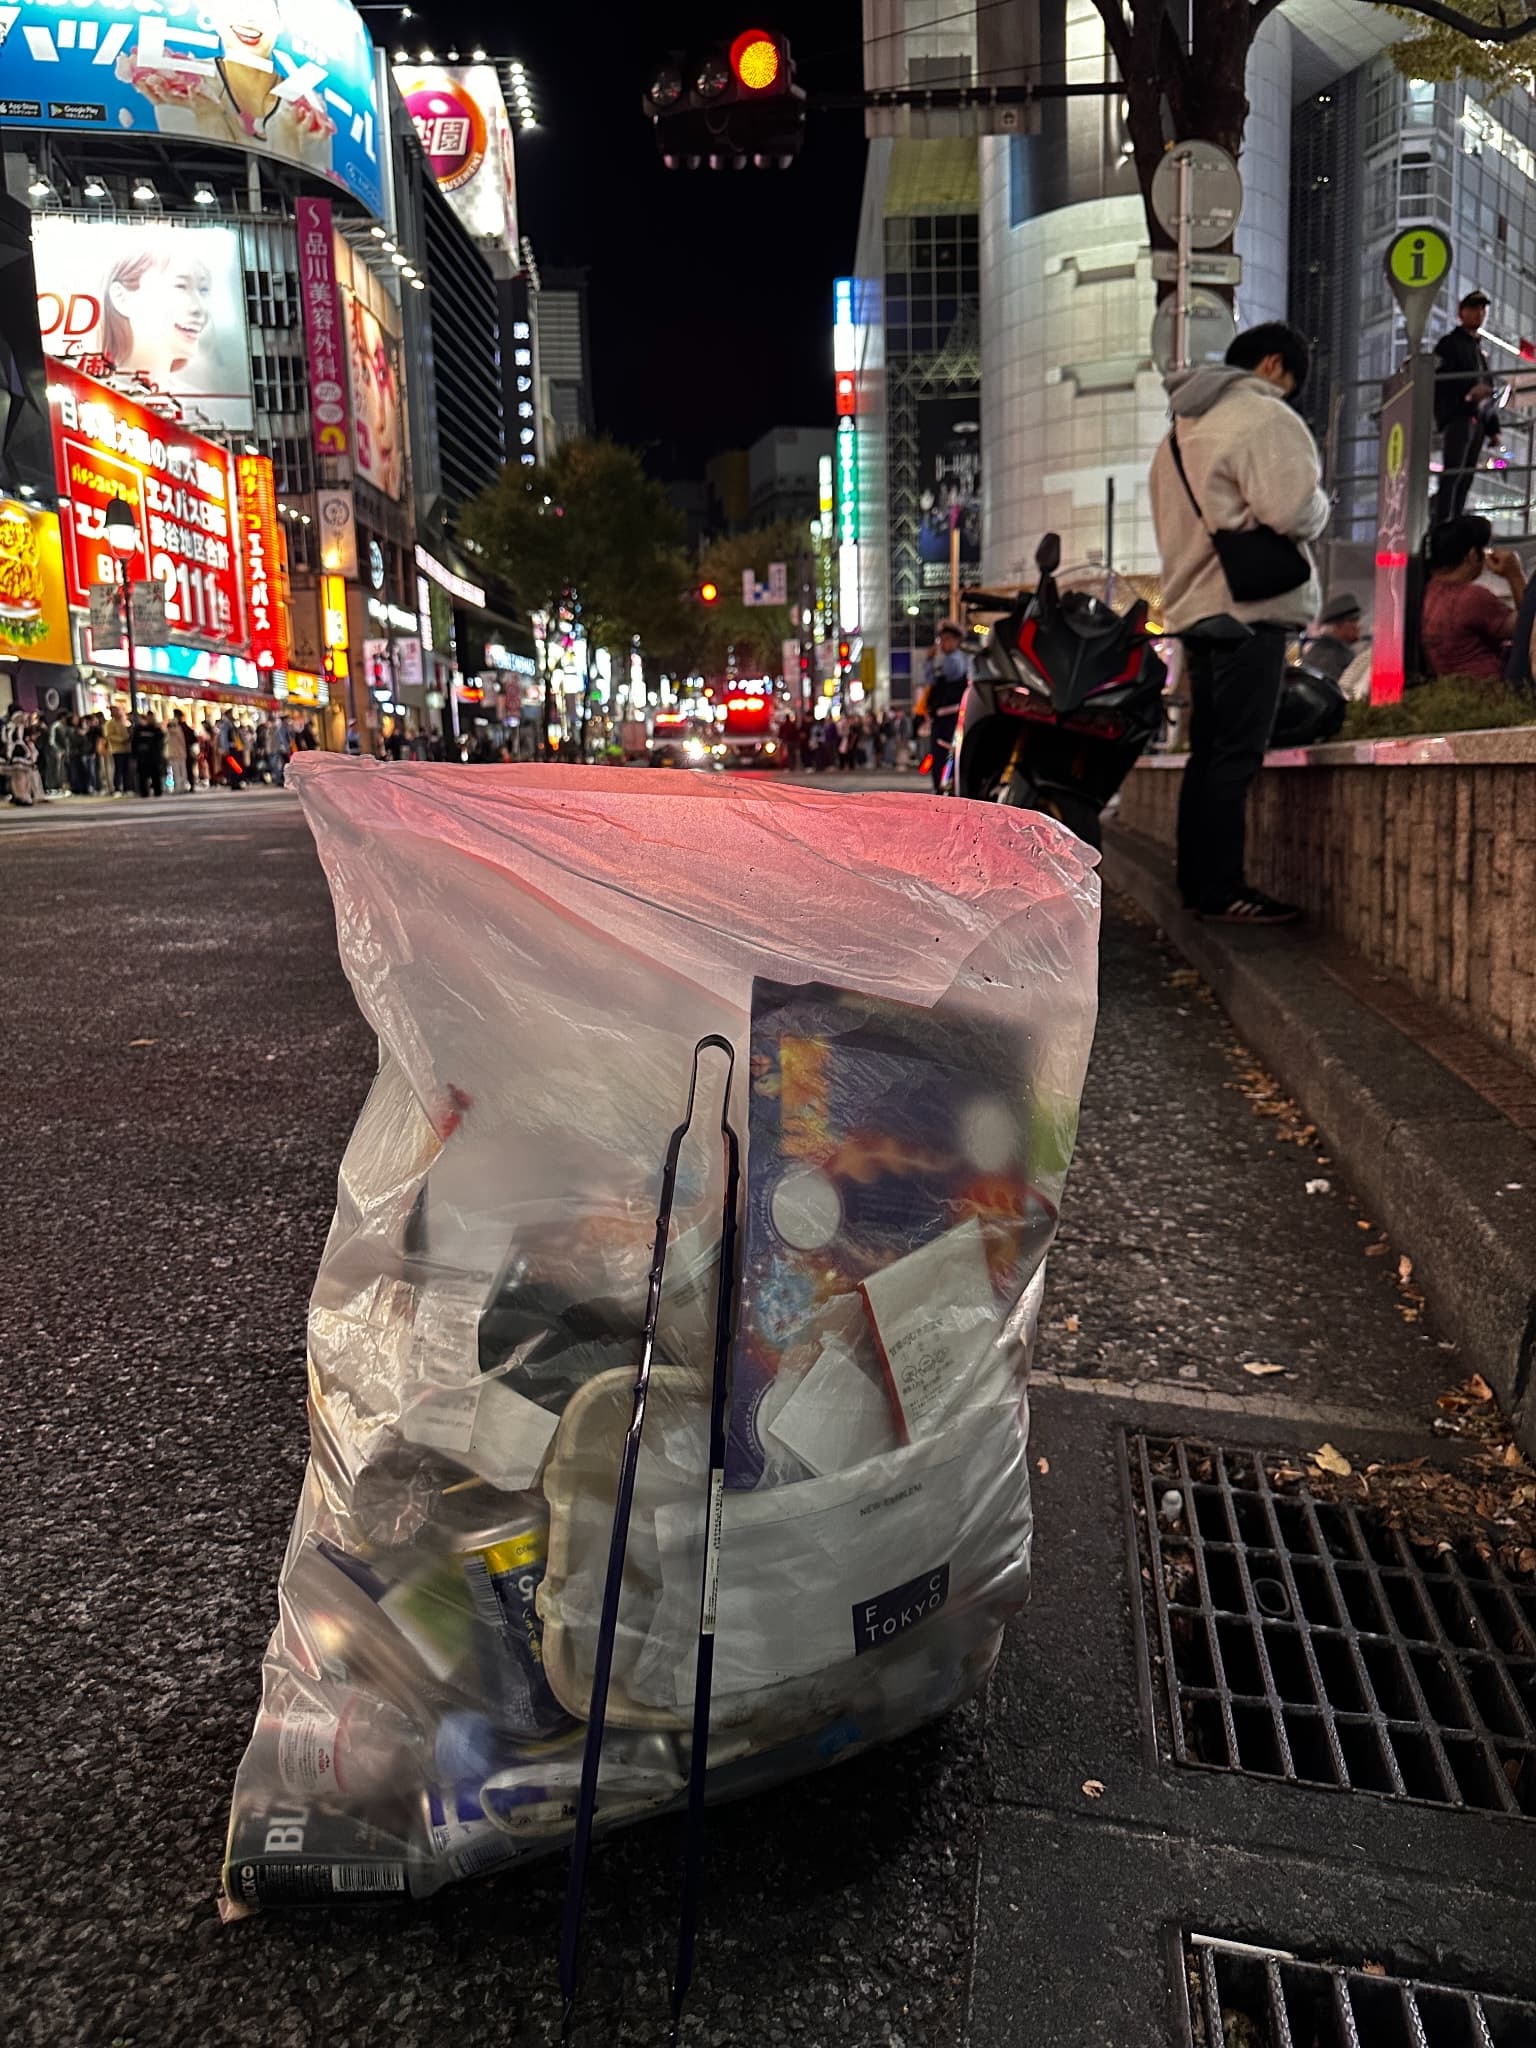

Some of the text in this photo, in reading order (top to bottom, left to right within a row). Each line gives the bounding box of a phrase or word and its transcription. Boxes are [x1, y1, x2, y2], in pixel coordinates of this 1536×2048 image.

[0, 6, 376, 164] ハッピーメール
[64, 105, 99, 115] Google Play
[1409, 238, 1430, 281] i
[304, 231, 337, 380] 品川美容外科
[860, 1483, 922, 1516] NEW EMBLEM
[865, 1574, 941, 1624] F C
[865, 1593, 941, 1641] TOKYO
[318, 1747, 327, 1775] evian
